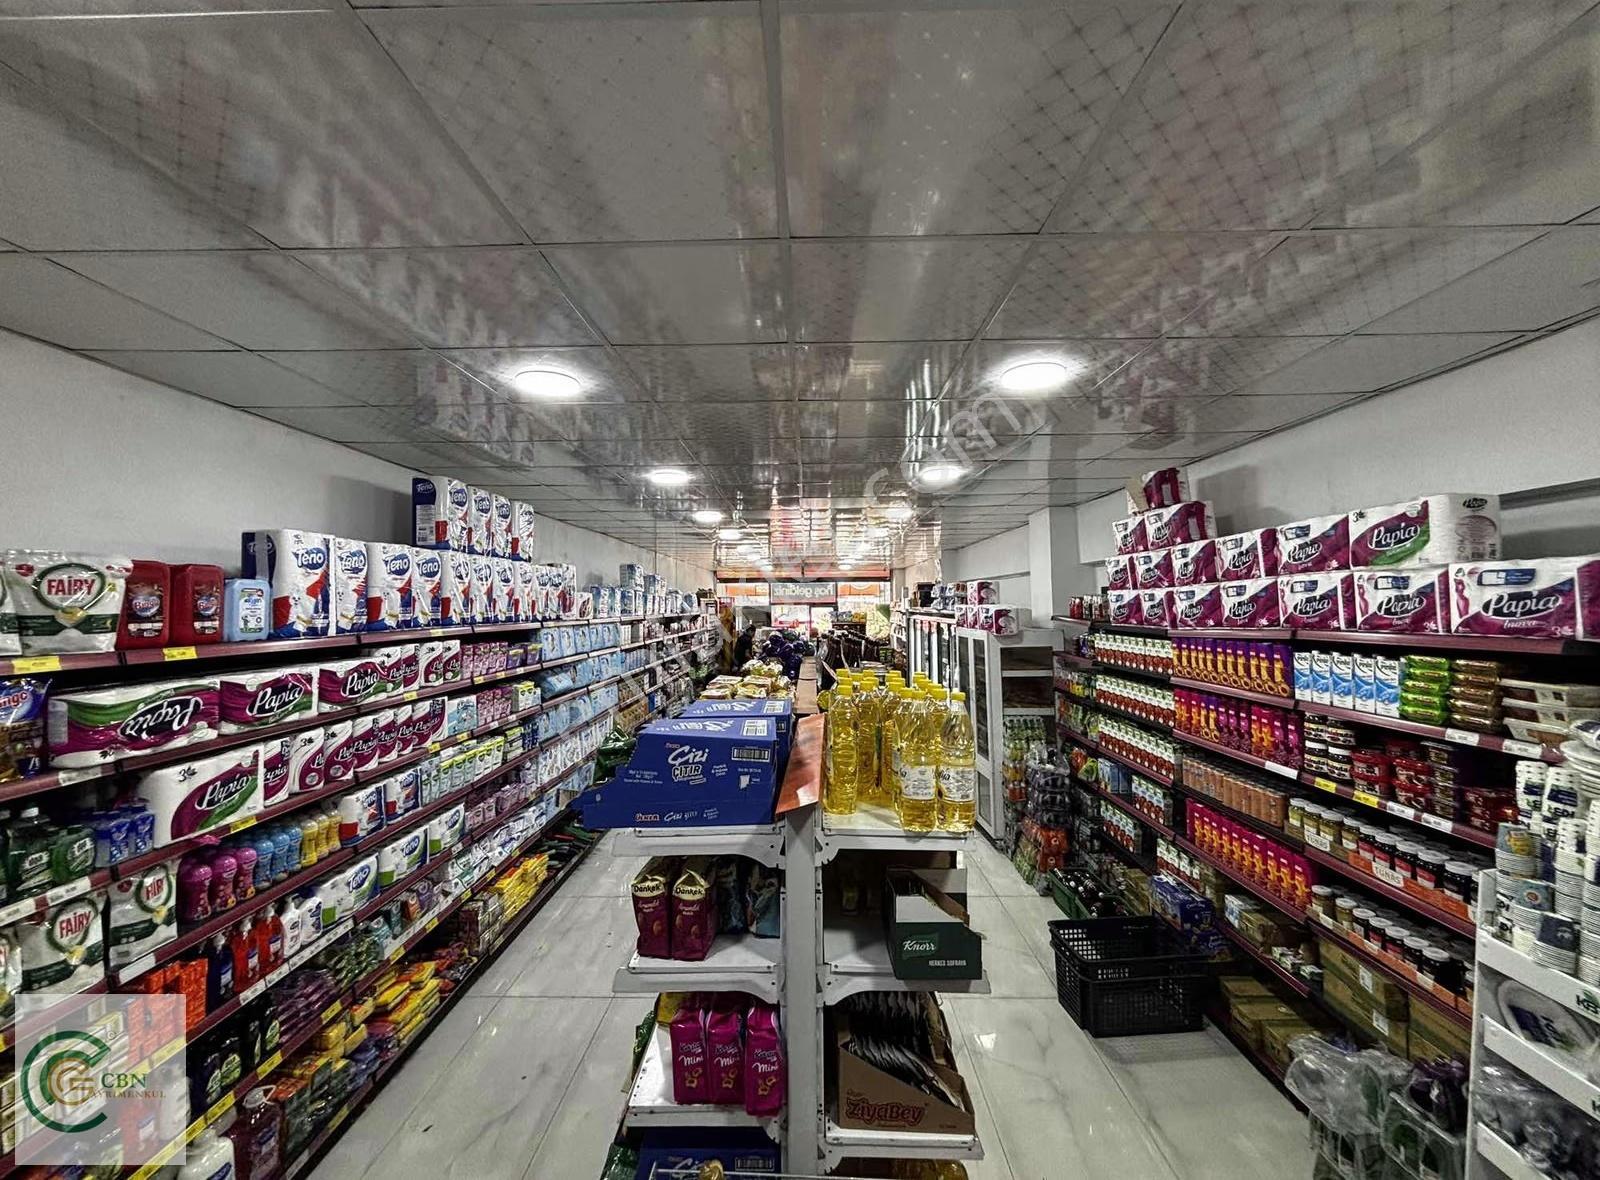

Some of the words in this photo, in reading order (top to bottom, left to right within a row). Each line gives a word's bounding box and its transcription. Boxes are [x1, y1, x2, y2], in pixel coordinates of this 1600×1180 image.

[1371, 522, 1419, 549] Papia
[292, 549, 324, 567] Teno
[1289, 542, 1321, 563] Papia
[383, 556, 410, 574] Teno
[417, 558, 439, 573] Teno
[47, 575, 96, 597] FAIRY
[1294, 596, 1331, 616] Papia
[1379, 594, 1424, 616] Papia
[1486, 591, 1561, 618] Papia
[345, 667, 379, 695] Papia
[254, 684, 303, 715] Papia
[121, 696, 203, 739] Papia
[264, 764, 287, 782] apia
[203, 774, 250, 808] Papia
[402, 837, 419, 856] Teno
[350, 865, 370, 892] Teno
[675, 886, 704, 896] Dankek
[58, 910, 93, 939] FAIRY
[902, 939, 937, 951] Knorr
